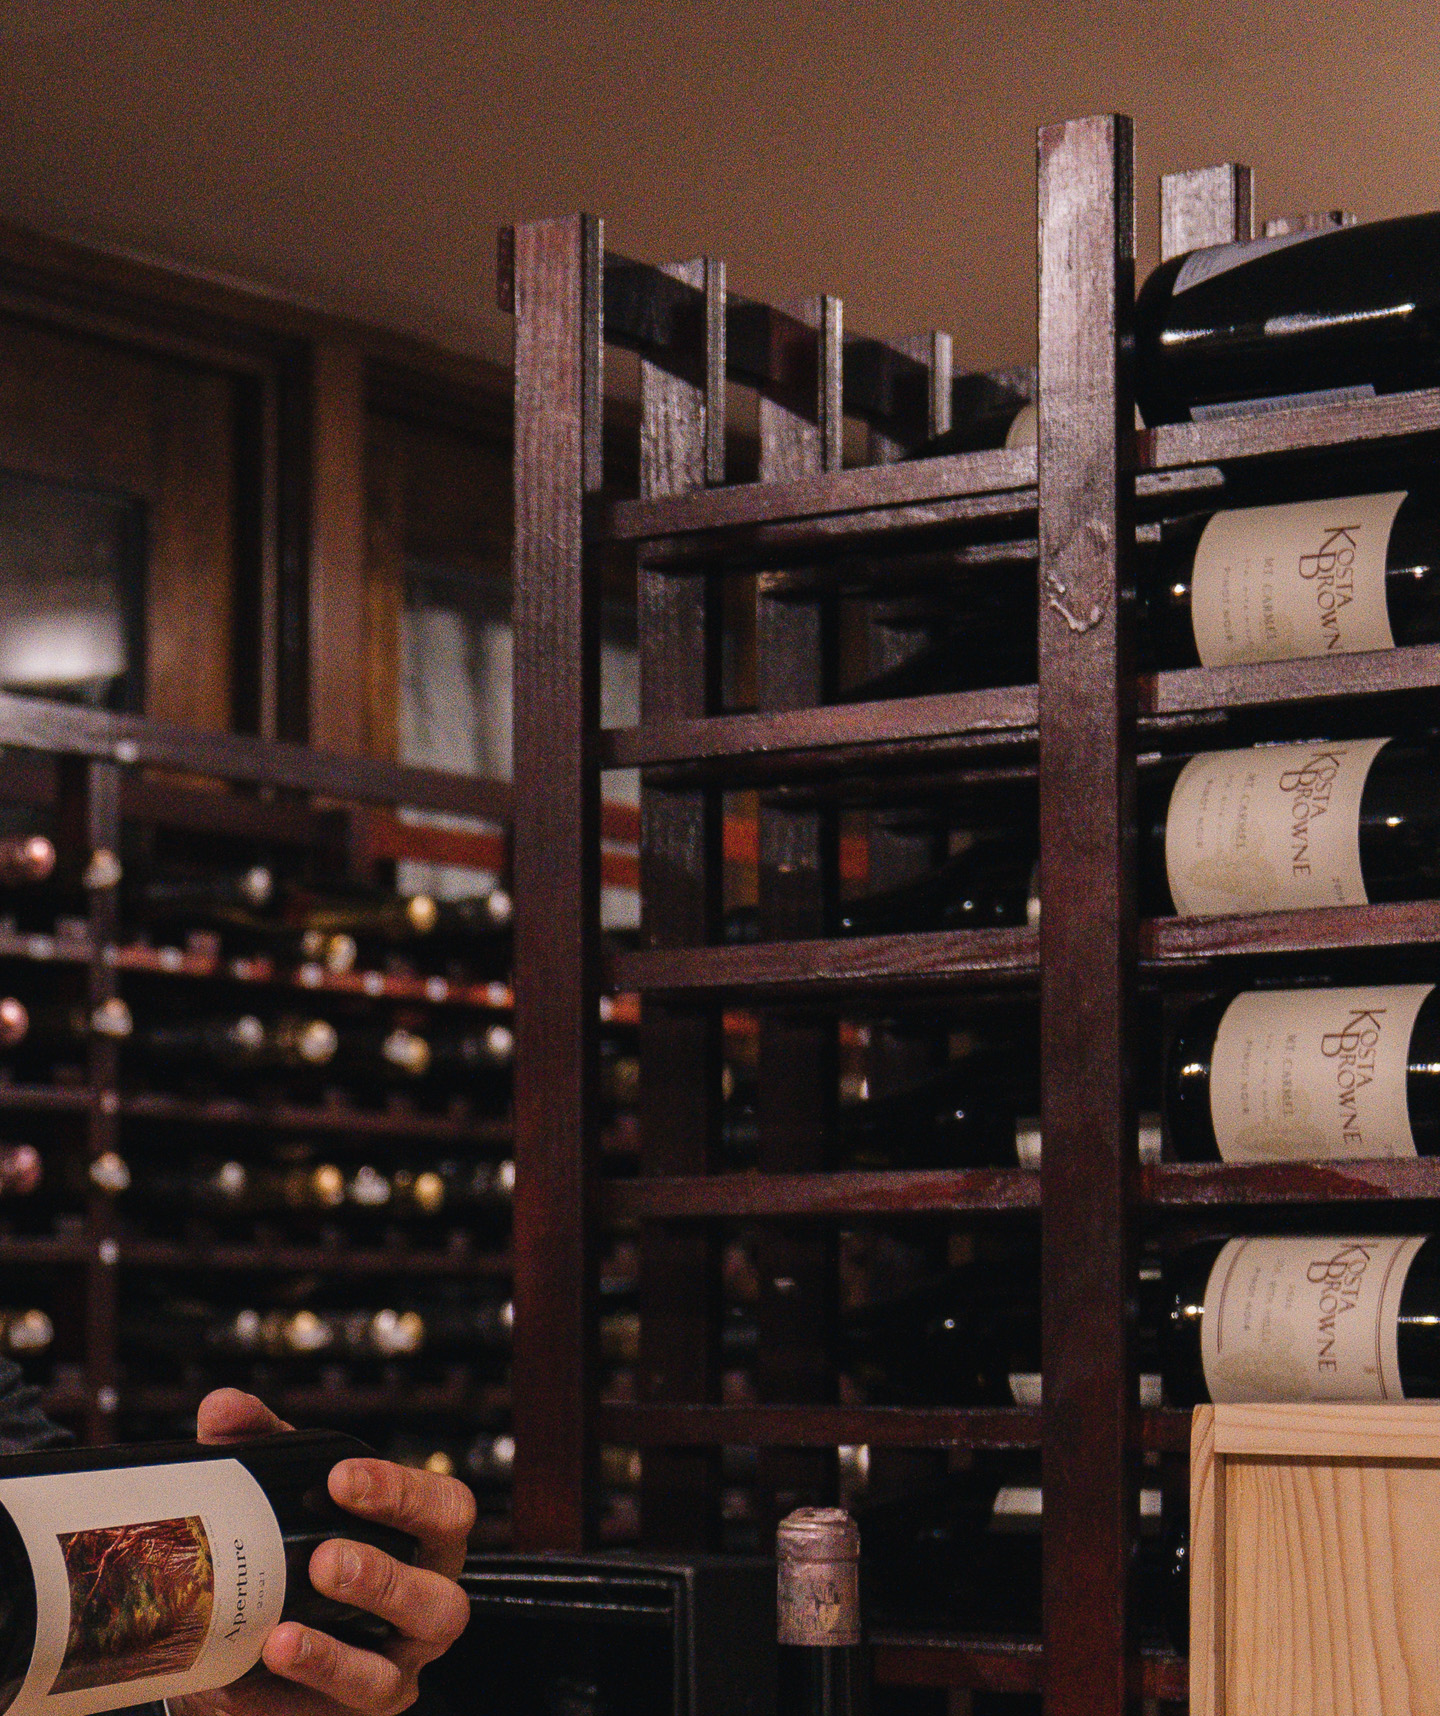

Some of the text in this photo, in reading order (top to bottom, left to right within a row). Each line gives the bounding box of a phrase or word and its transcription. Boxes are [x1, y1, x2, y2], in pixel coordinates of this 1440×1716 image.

[1318, 524, 1361, 609] KOSTA
[1279, 770, 1320, 877] BROWNE
[1302, 750, 1348, 819] KOSTA
[1321, 1033, 1363, 1145] BROWNE
[1342, 1008, 1387, 1089] KOSTA
[1306, 1261, 1347, 1372] BROWNE
[1331, 1242, 1379, 1314] KOSTA
[224, 1538, 248, 1644] Aperture
[256, 1570, 266, 1610] 2021
